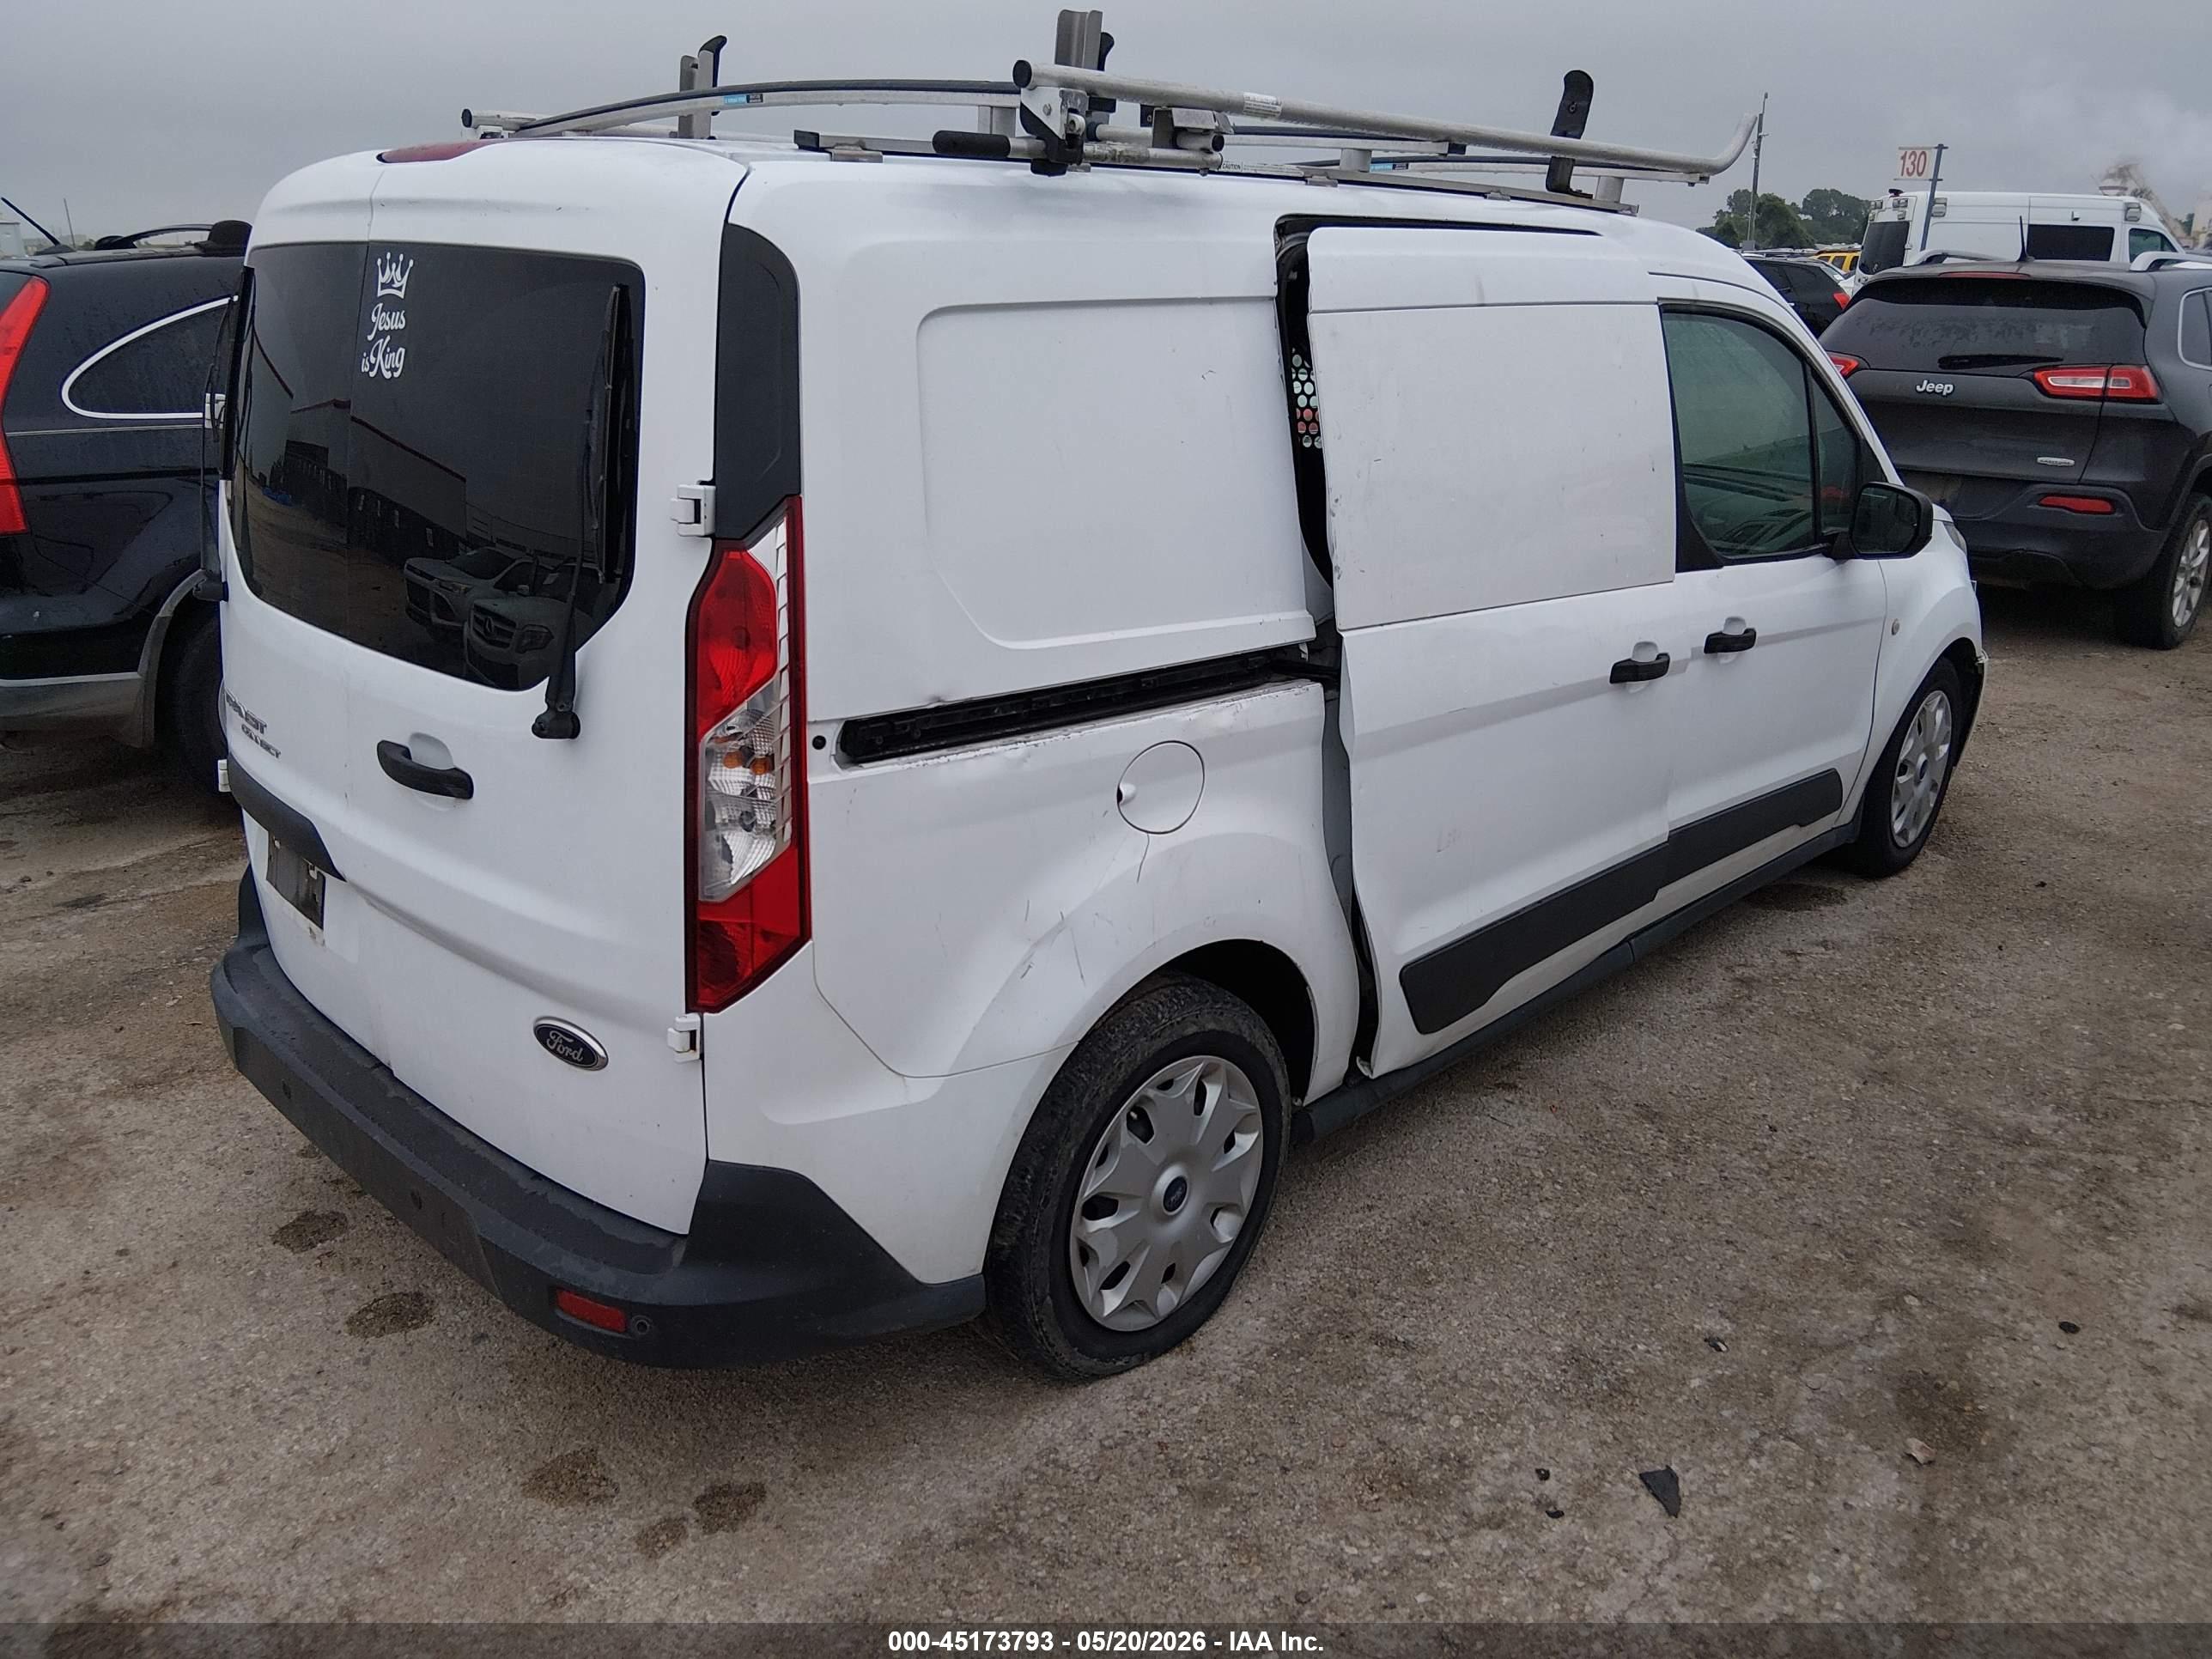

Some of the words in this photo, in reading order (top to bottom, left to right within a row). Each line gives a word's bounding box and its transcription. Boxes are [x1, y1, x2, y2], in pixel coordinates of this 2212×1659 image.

[1900, 150, 1928, 177] 130
[367, 302, 406, 341] Jesus
[361, 351, 370, 373] is
[368, 335, 406, 379] King
[1916, 380, 1954, 396] Jeep
[546, 1030, 584, 1062] Ford
